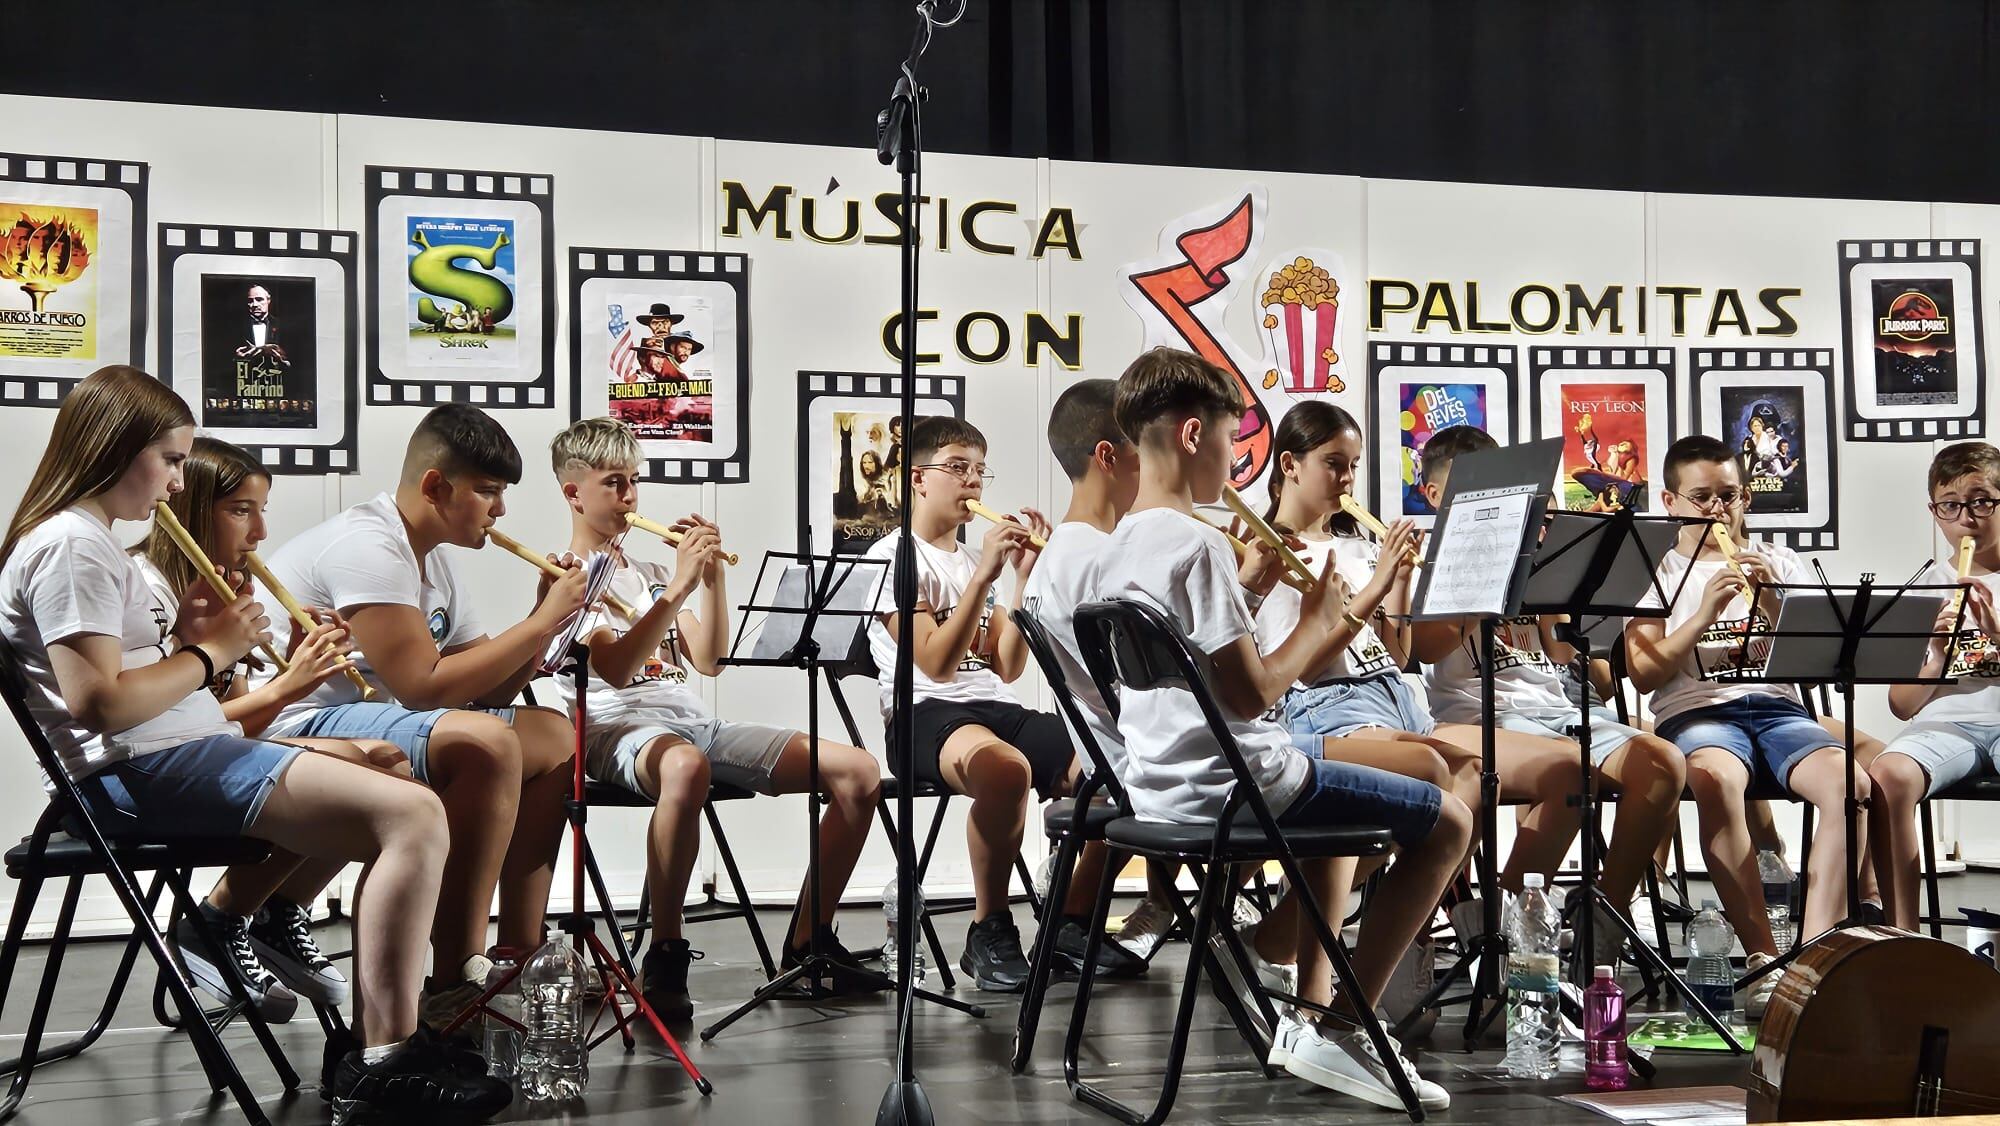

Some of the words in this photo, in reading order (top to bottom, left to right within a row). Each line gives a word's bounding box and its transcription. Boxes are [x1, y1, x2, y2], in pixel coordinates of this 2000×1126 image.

[721, 176, 1083, 260] MÚSICA
[1369, 278, 1802, 337] PALOMITAS
[0, 311, 31, 323] ARROS
[33, 313, 47, 324] DE
[50, 313, 86, 327] FUEGO
[1883, 319, 1921, 333] JURASSIC
[1922, 319, 1946, 332] PARK
[880, 309, 1084, 370] CON
[236, 379, 284, 397] Padrino
[658, 382, 678, 396] FEO
[1423, 387, 1456, 411] DEL
[1571, 401, 1599, 413] REY
[1424, 400, 1467, 429] REVÉS
